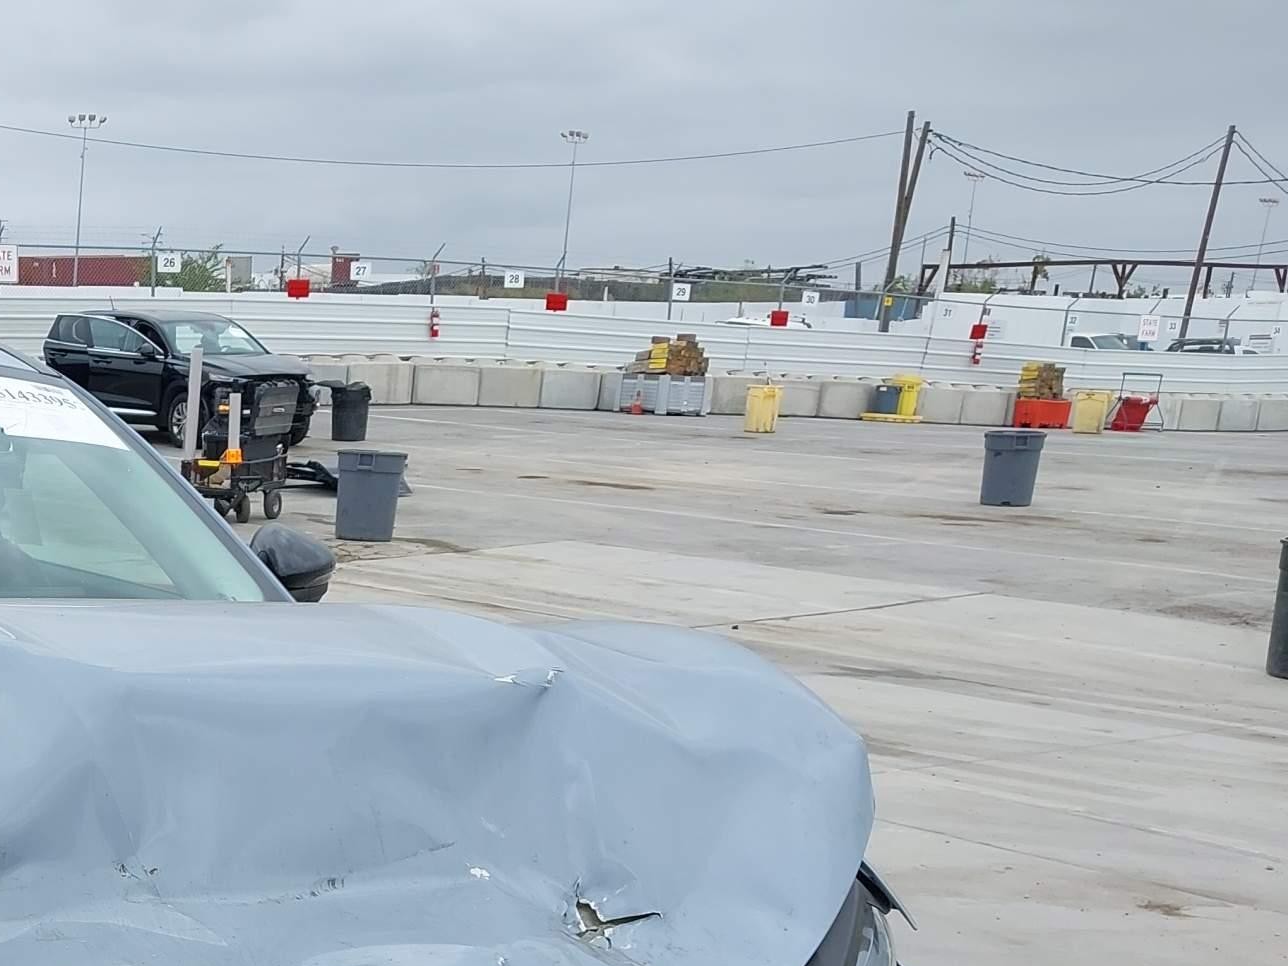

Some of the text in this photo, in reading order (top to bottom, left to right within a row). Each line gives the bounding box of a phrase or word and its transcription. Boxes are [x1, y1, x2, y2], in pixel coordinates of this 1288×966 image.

[163, 257, 176, 268] 26
[355, 266, 367, 276] 27
[509, 274, 520, 284] 28
[676, 287, 687, 297] 29
[806, 294, 815, 304] 30
[943, 308, 952, 318] 31
[1142, 318, 1158, 327] STATE
